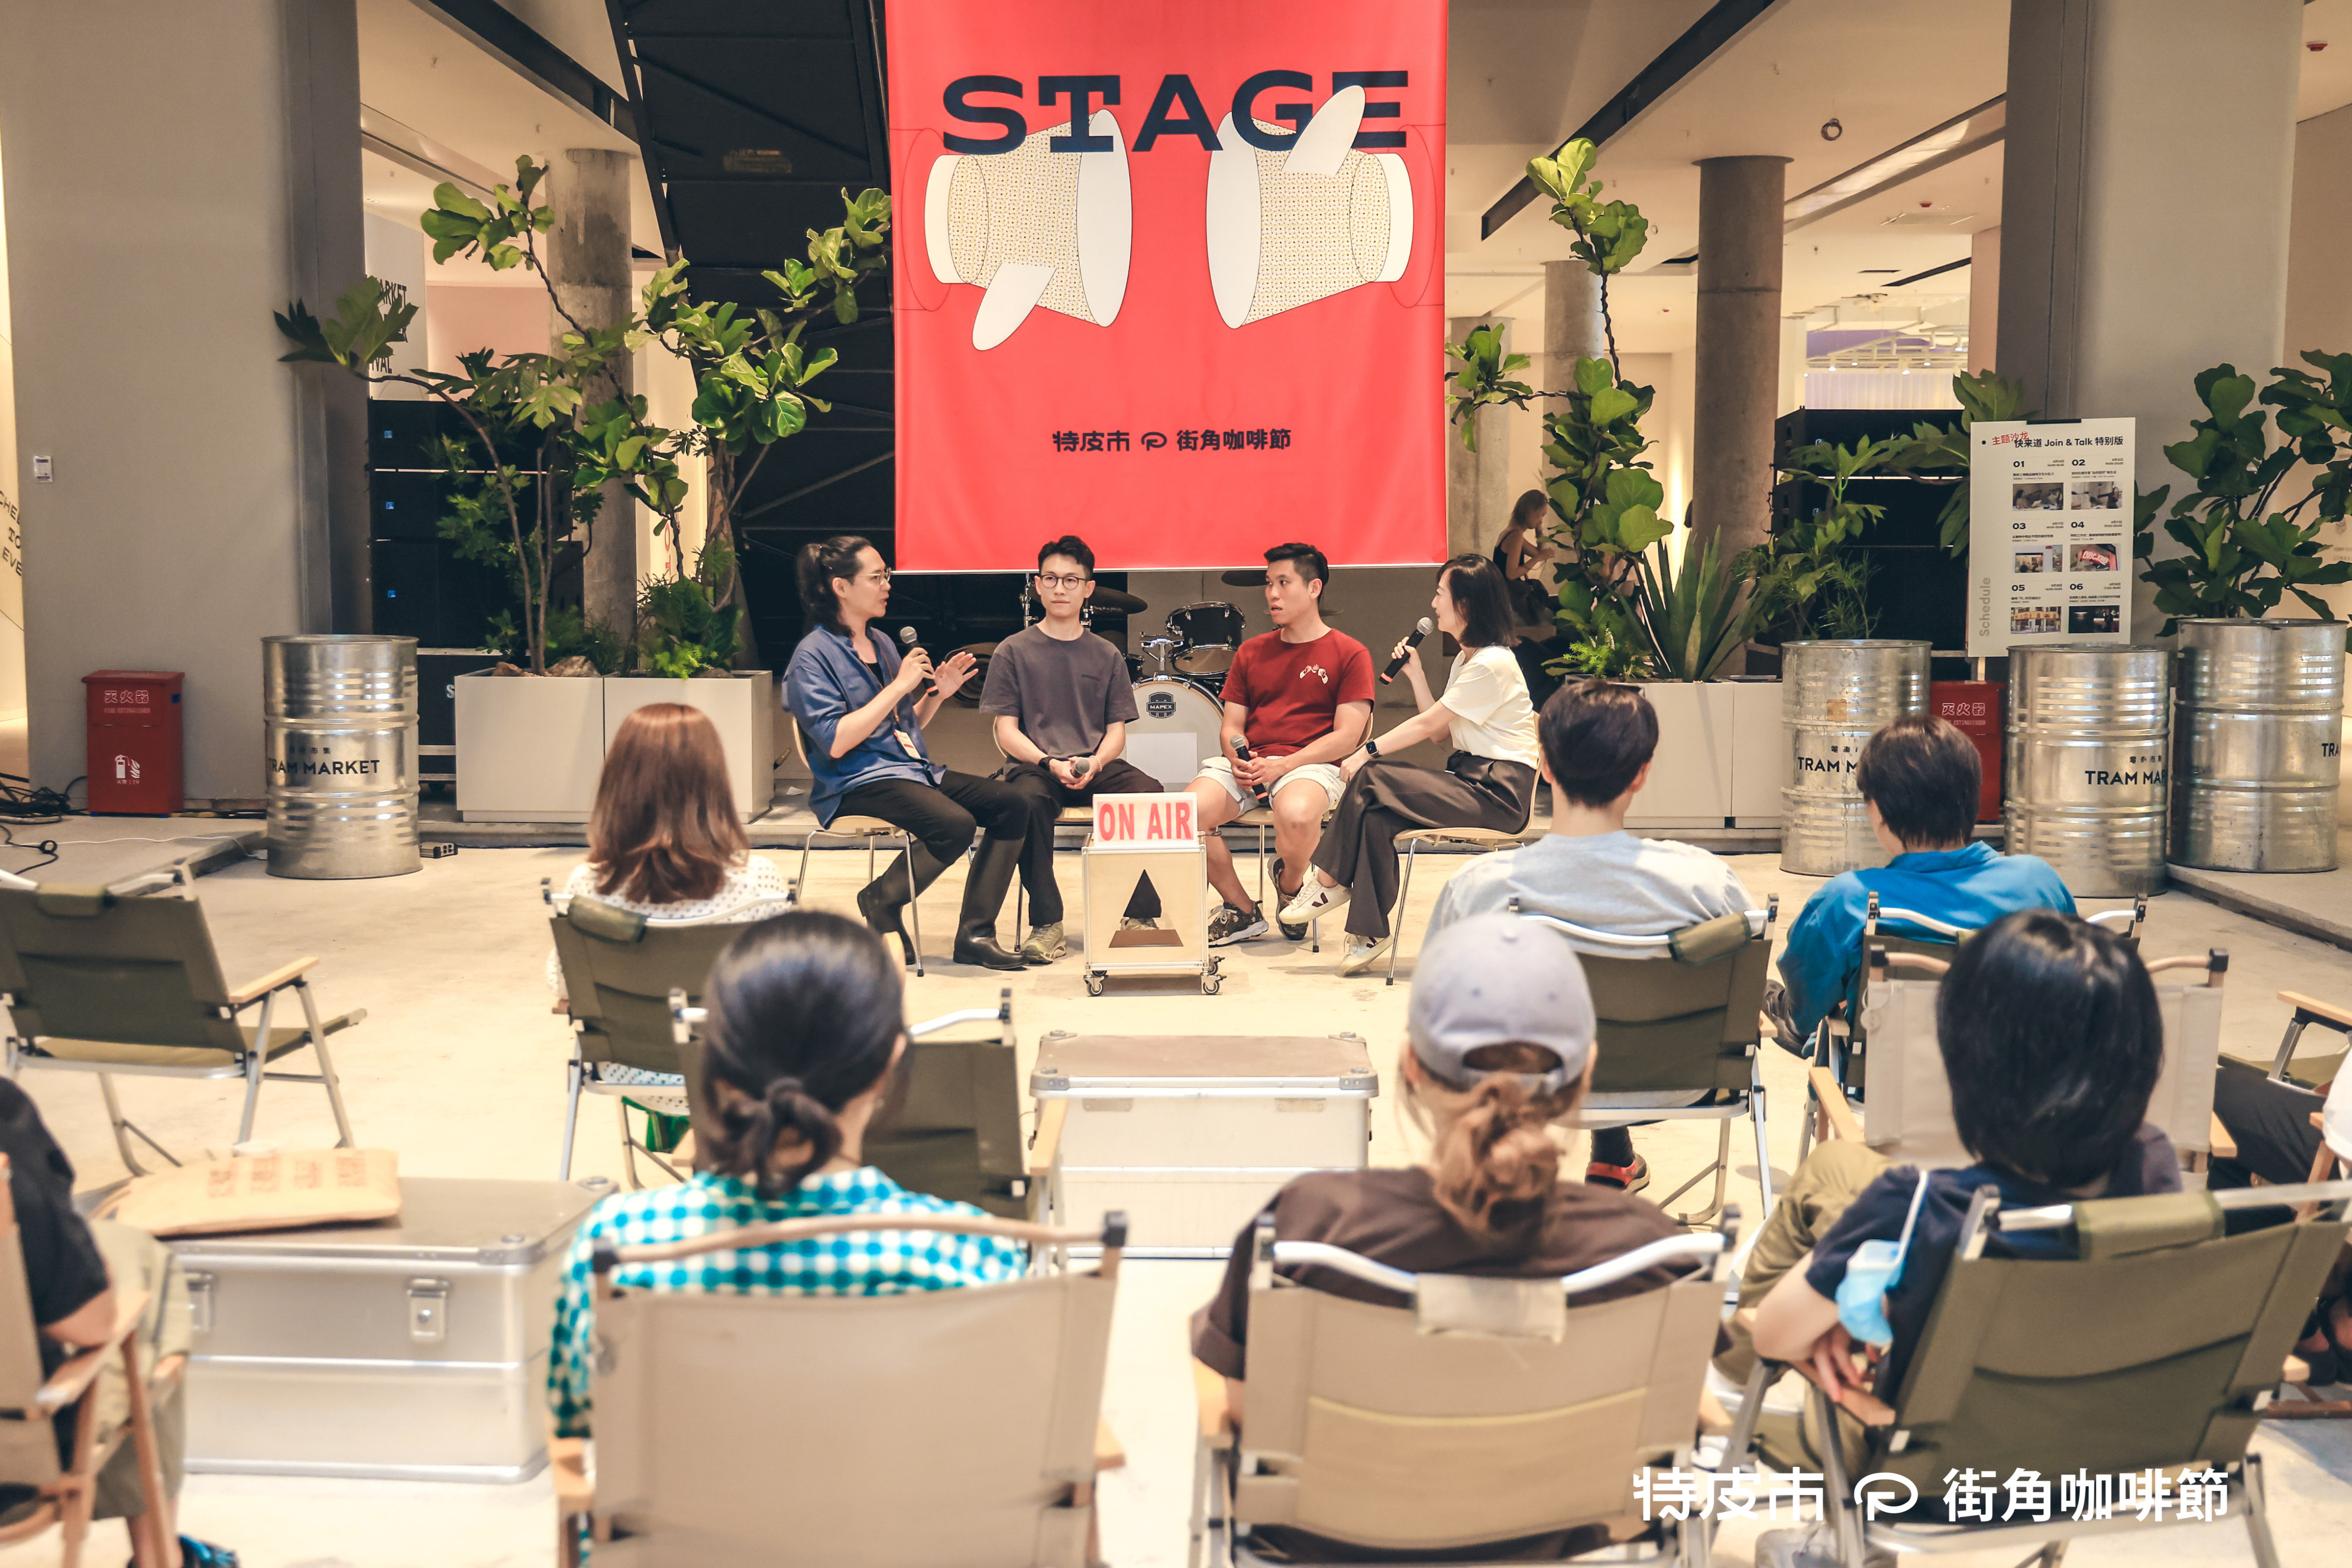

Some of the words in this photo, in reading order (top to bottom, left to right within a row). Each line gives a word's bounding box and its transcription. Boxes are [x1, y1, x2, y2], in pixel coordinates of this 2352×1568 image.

[943, 70, 1408, 155] STAGE
[1052, 430, 1130, 452] 特皮市
[1176, 428, 1292, 451] 街角咖啡節
[1992, 432, 2029, 446] 主题沙龙
[2014, 438, 2042, 448] 快来道
[2044, 439, 2063, 447] Join
[2075, 438, 2093, 446] Talk
[2095, 436, 2123, 446] 特别版
[1979, 577, 1991, 637] Schedule
[104, 690, 149, 704] 灭火器
[1942, 702, 1985, 716] 灭火器
[269, 757, 297, 773] TRAM
[303, 759, 380, 775] MARKET
[1798, 757, 1840, 772] TRAM
[2085, 770, 2138, 785] TRAM
[1099, 804, 1135, 841] ON
[1147, 802, 1192, 840] AIR
